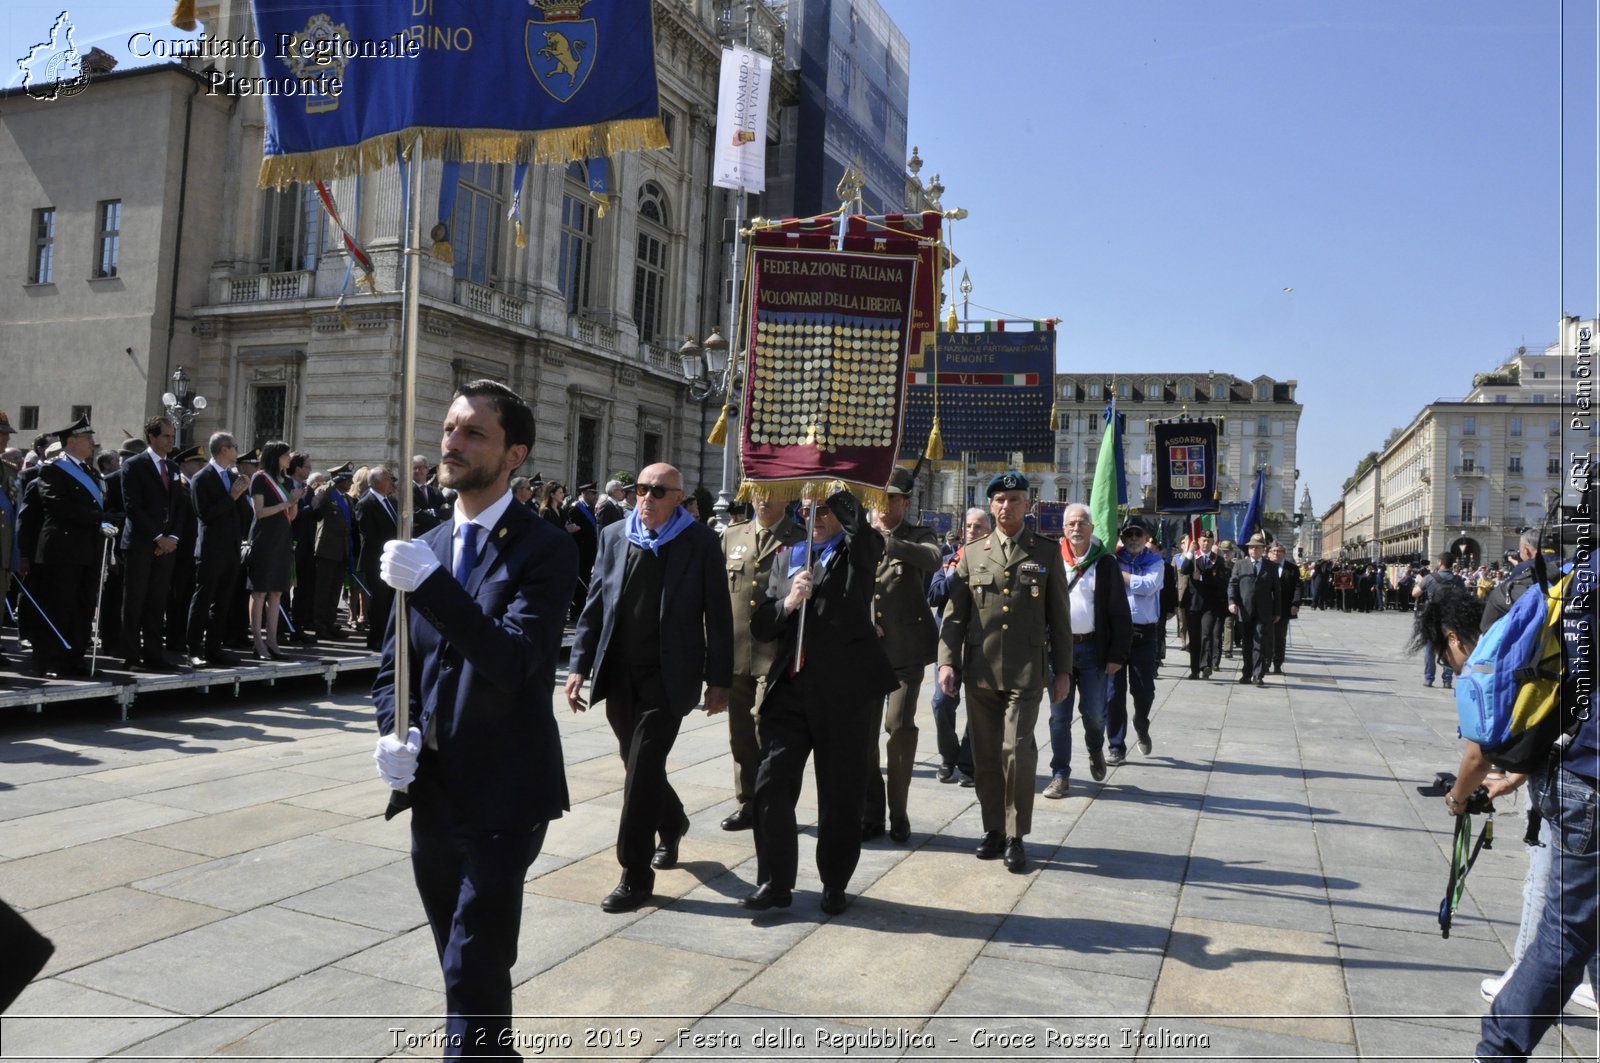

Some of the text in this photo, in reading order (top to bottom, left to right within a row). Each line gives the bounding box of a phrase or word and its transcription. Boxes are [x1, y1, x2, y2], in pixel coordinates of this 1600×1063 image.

[734, 54, 749, 128] LEONARDO
[749, 71, 761, 109] VINCI
[748, 112, 757, 131] DA
[763, 258, 904, 283] FEDERAZIONE ITALIANA
[760, 288, 904, 313] VOLONTARI DELLA LIBERTA
[945, 353, 995, 363] PIEMONTE
[1165, 436, 1207, 446] ASSOARMA
[1173, 491, 1202, 499] TORINO
